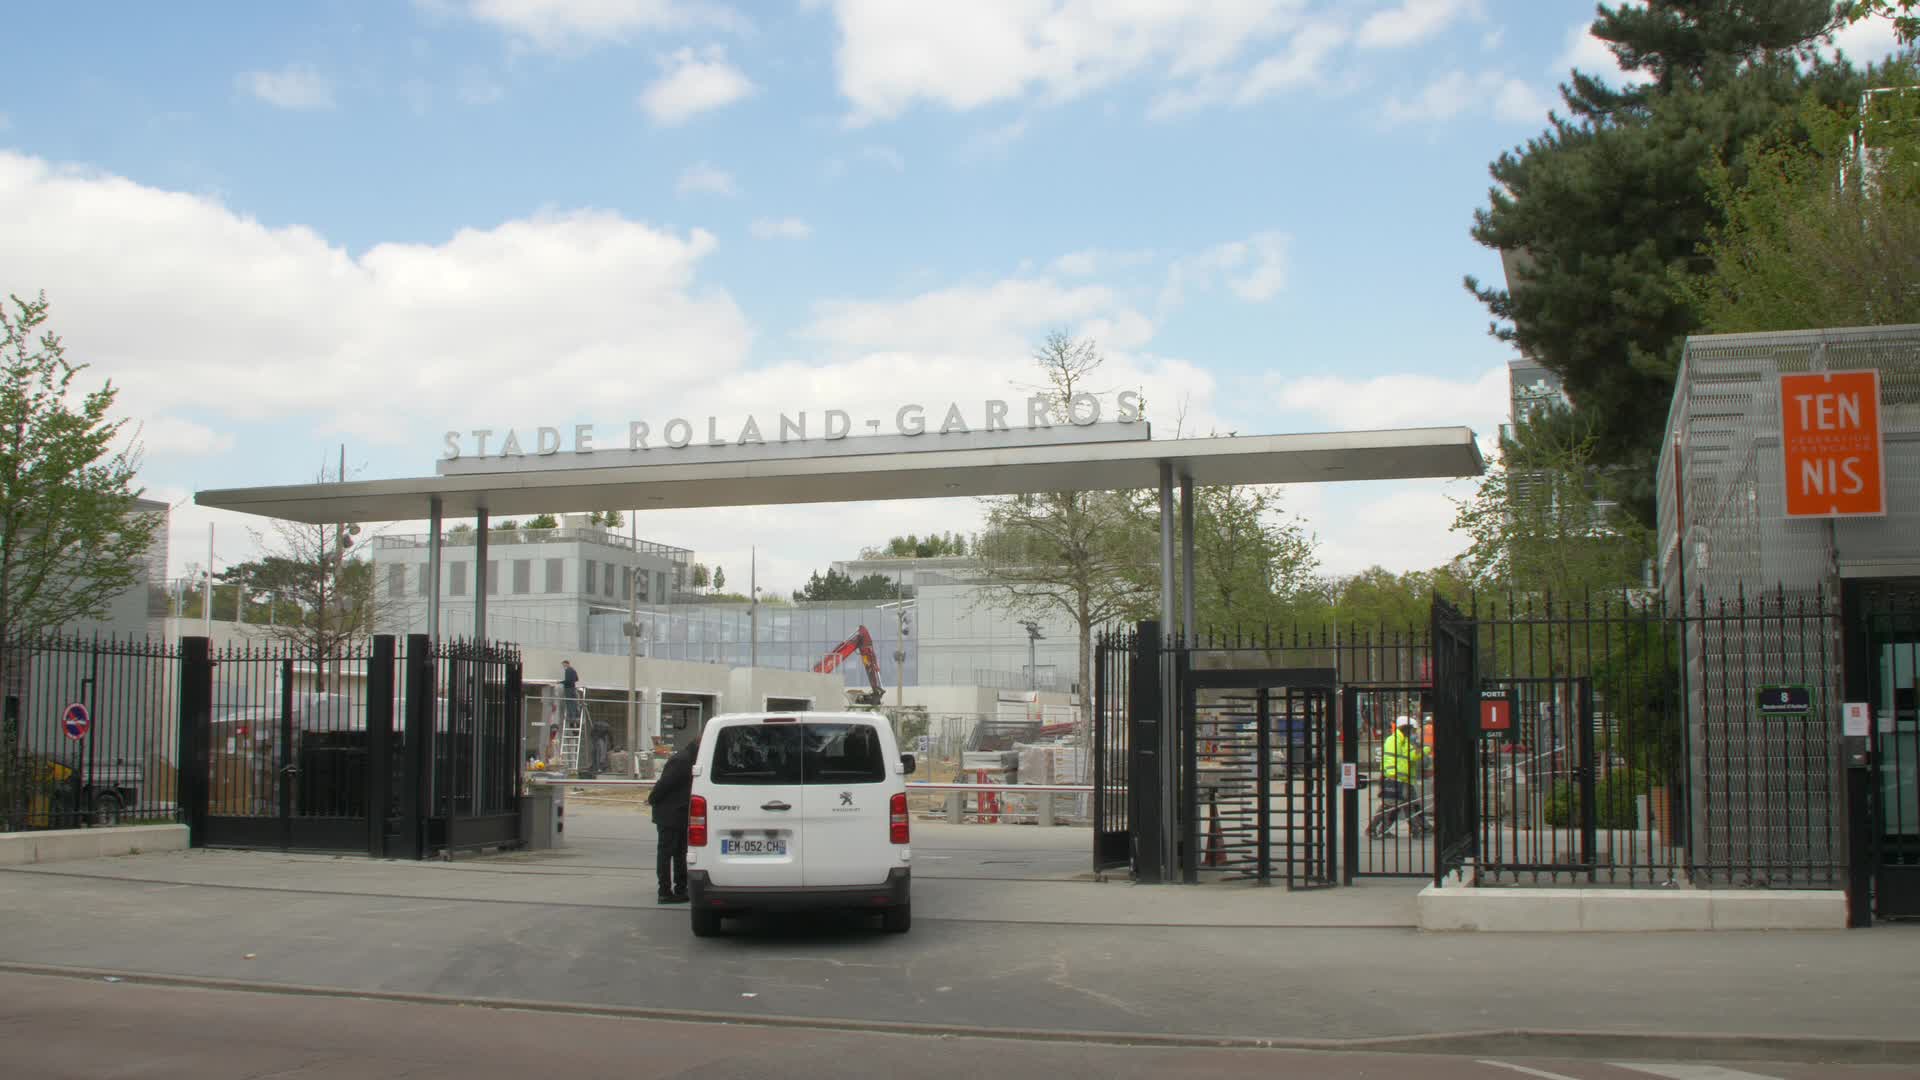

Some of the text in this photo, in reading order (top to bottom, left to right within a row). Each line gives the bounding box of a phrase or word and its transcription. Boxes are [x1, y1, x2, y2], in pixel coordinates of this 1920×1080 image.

[443, 391, 1139, 461] STADE ROLAND-GARROS
[1795, 393, 1861, 431] TEN
[1801, 457, 1864, 496] NIS
[1780, 692, 1789, 702] 8
